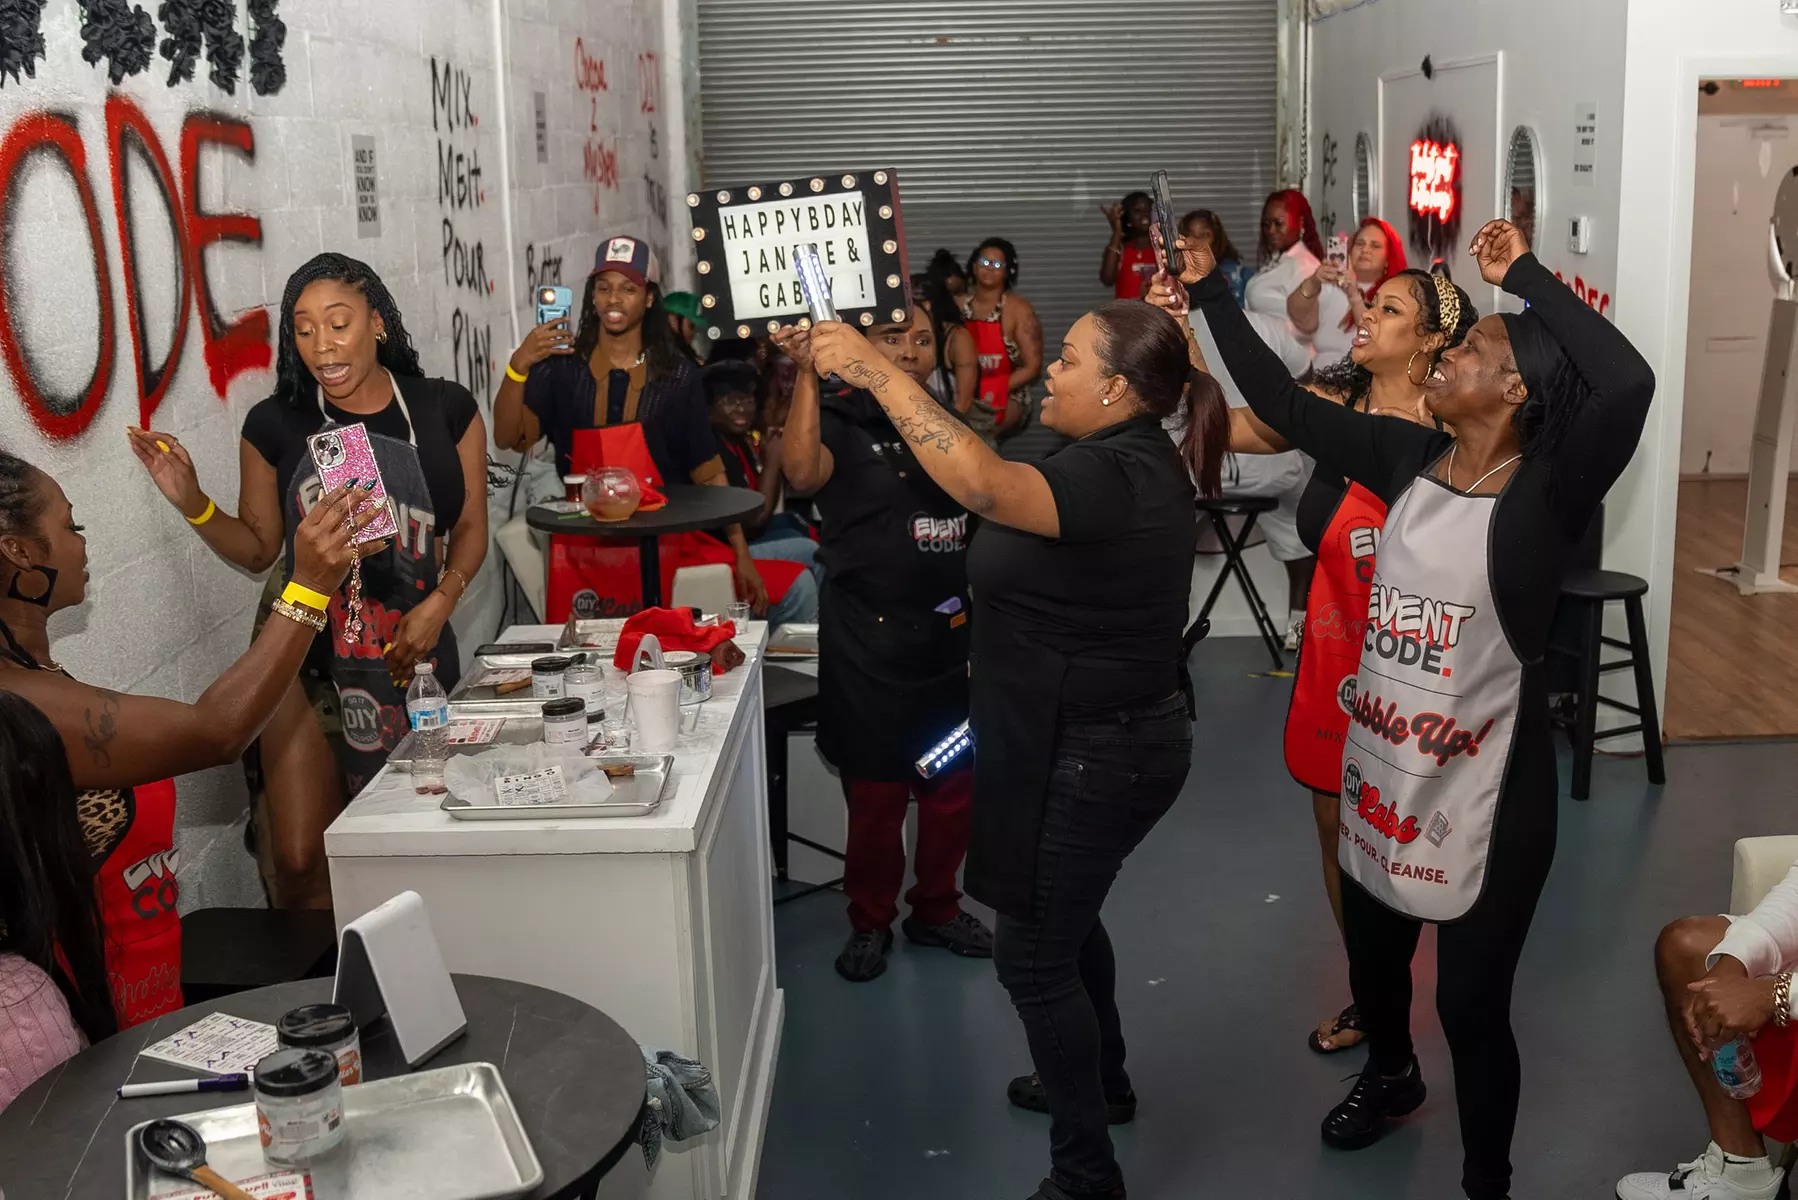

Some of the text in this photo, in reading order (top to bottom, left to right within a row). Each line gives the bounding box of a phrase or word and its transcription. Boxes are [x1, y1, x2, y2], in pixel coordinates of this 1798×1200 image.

[743, 241, 836, 275] JANE
[913, 512, 968, 540] EVENT
[1368, 582, 1475, 651] EVENT
[344, 707, 377, 729] DIY
[1410, 711, 1495, 767] Up!
[1354, 832, 1380, 863] POUR.
[1380, 855, 1449, 885] CLEANSE.
